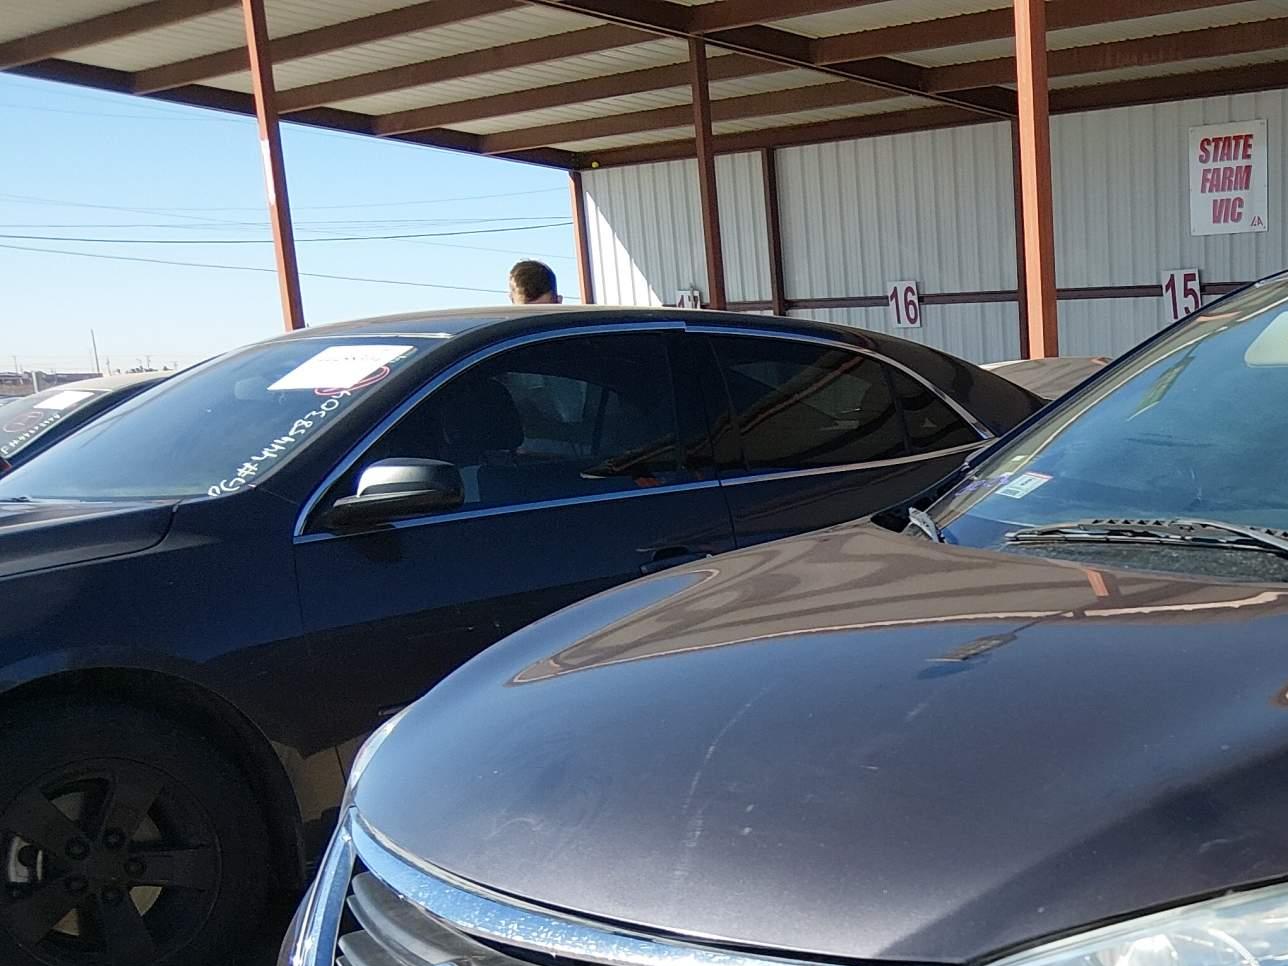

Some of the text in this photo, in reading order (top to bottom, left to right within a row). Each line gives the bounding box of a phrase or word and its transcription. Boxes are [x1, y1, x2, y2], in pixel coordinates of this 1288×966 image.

[1198, 133, 1254, 165] STATE
[1200, 164, 1253, 194] FARM
[1211, 196, 1245, 225] VIC
[889, 286, 919, 324] 16
[1163, 272, 1200, 320] 15
